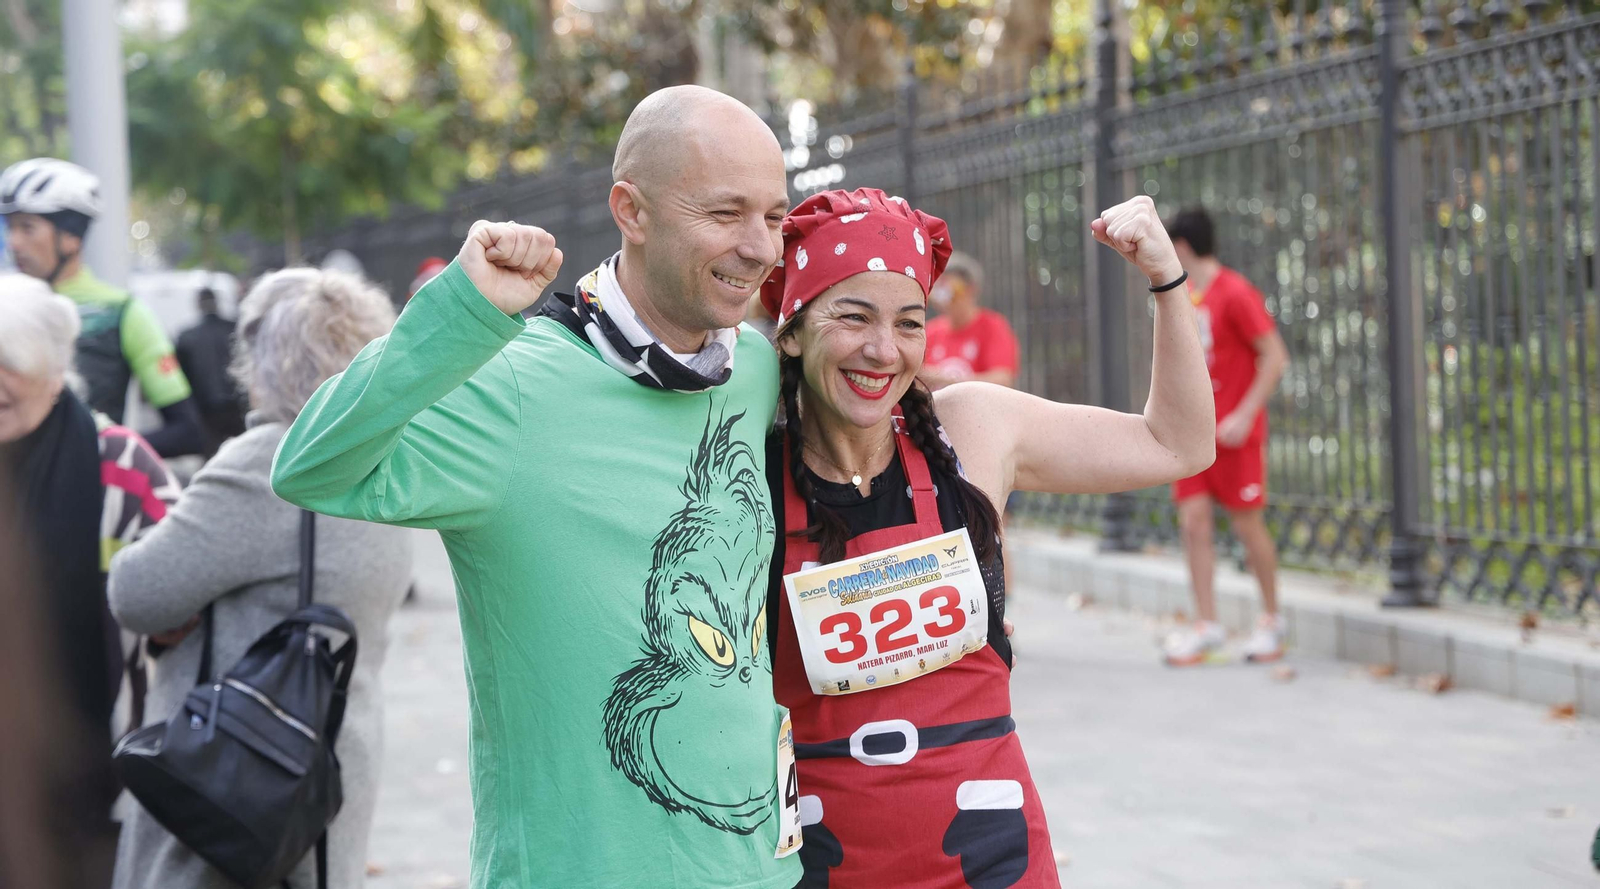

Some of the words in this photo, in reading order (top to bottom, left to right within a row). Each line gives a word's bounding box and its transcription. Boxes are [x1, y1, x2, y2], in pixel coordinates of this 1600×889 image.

[828, 568, 886, 598] CARRERA
[884, 553, 940, 583] NAVIDAD
[869, 554, 899, 569] EDICIÓN
[799, 586, 826, 598] EVOS
[873, 586, 894, 597] CIUDAD
[902, 572, 942, 589] ALGECIRAS
[819, 585, 967, 664] 323
[857, 657, 884, 671] NATERA
[885, 650, 916, 664] PIZARRO,
[917, 644, 935, 656] MARI
[936, 639, 949, 650] LUZ
[785, 762, 798, 813] 4
